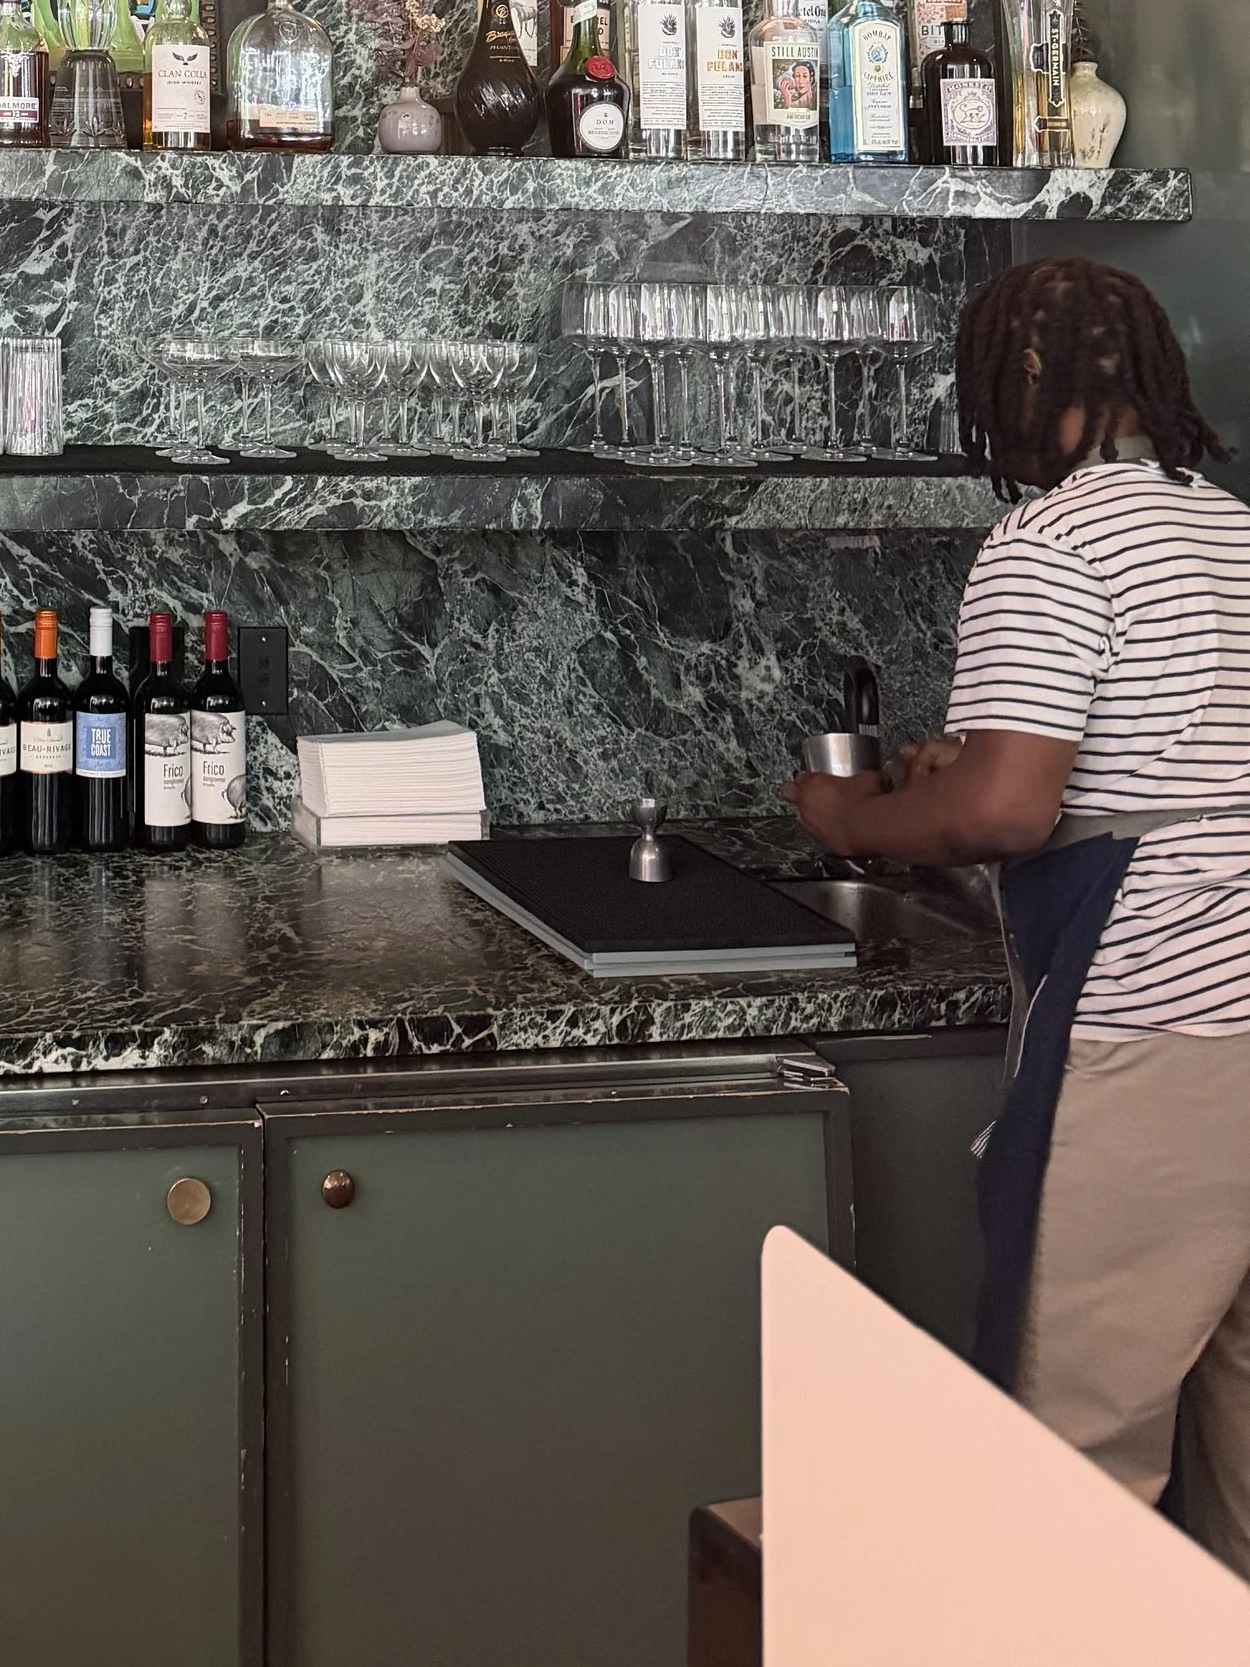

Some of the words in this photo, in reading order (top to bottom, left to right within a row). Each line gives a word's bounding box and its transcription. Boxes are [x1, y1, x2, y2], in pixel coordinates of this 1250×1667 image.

[862, 29, 892, 41] BOMBAY
[771, 46, 795, 58] STILL
[648, 57, 685, 70] FULAN
[706, 61, 743, 73] FULAN
[157, 69, 182, 78] CLAN
[91, 728, 111, 744] TRUE
[90, 744, 111, 756] COAST
[163, 763, 184, 778] Frico
[202, 760, 225, 776] Frico
